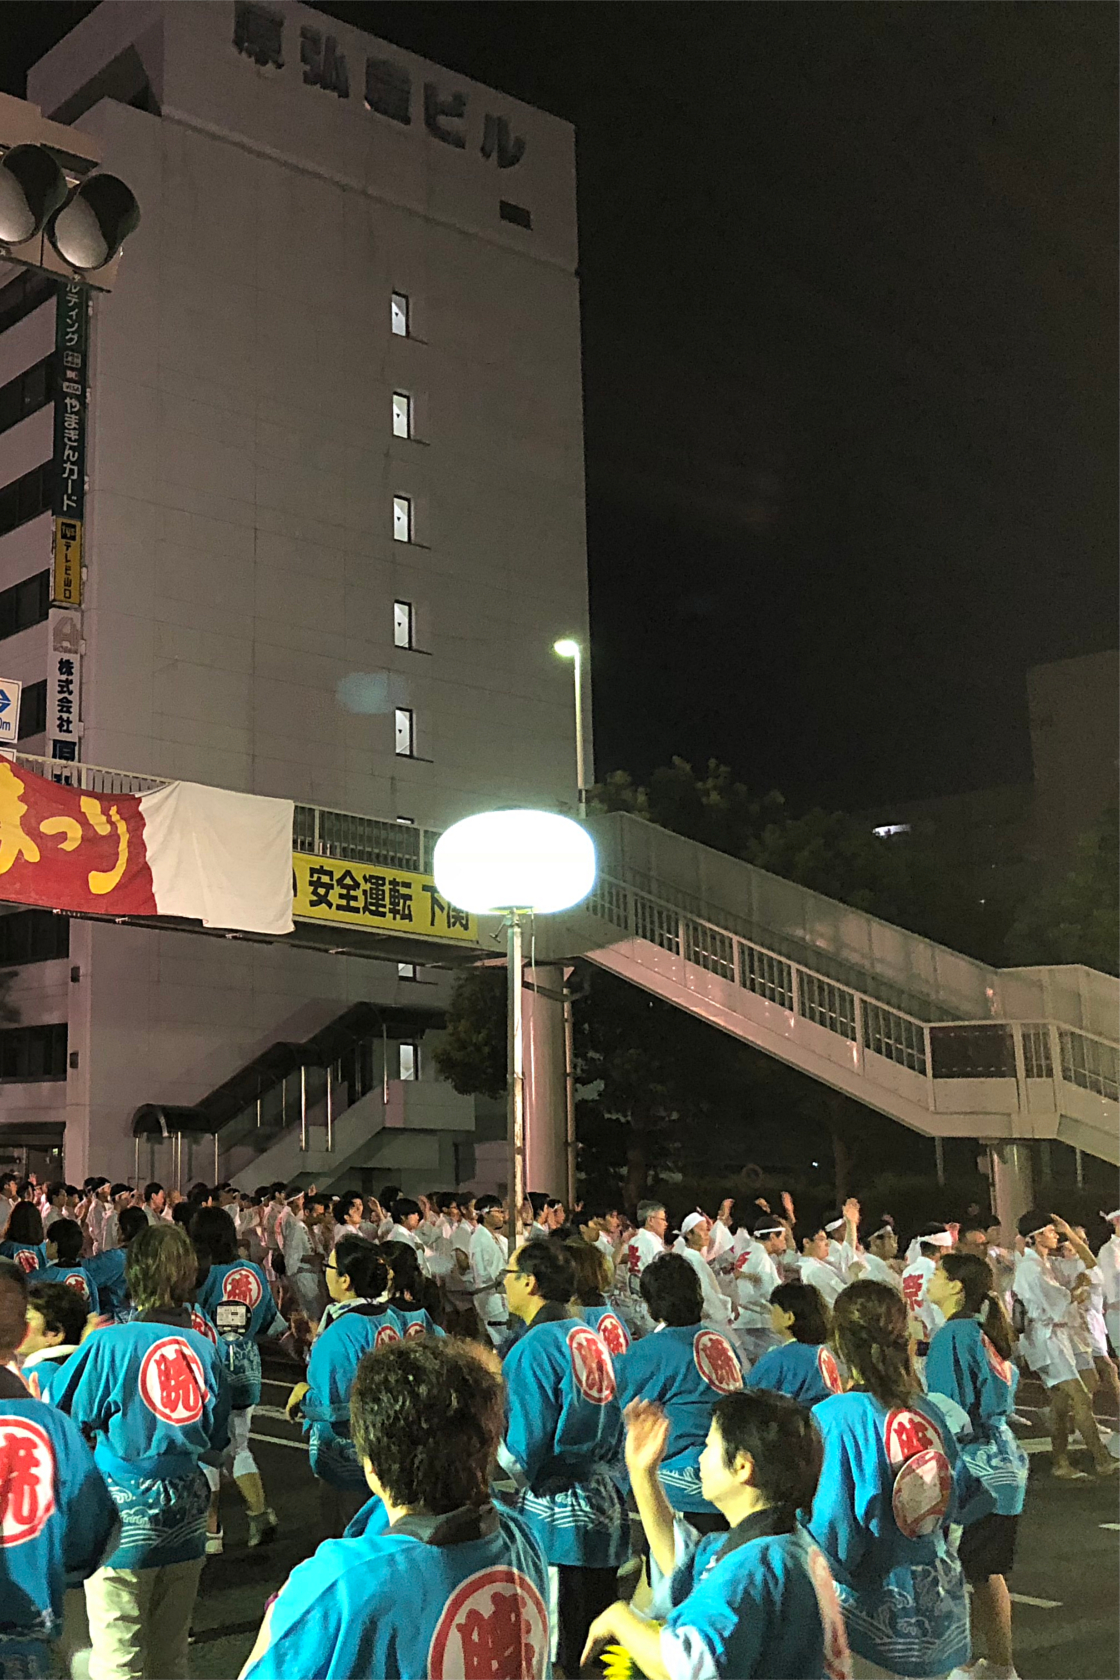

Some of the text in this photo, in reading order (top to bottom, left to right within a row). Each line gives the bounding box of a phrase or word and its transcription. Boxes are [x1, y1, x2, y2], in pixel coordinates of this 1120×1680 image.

[62, 396, 79, 511] やまぎんカード
[56, 657, 75, 734] 株式会社
[308, 865, 413, 923] 安全運転
